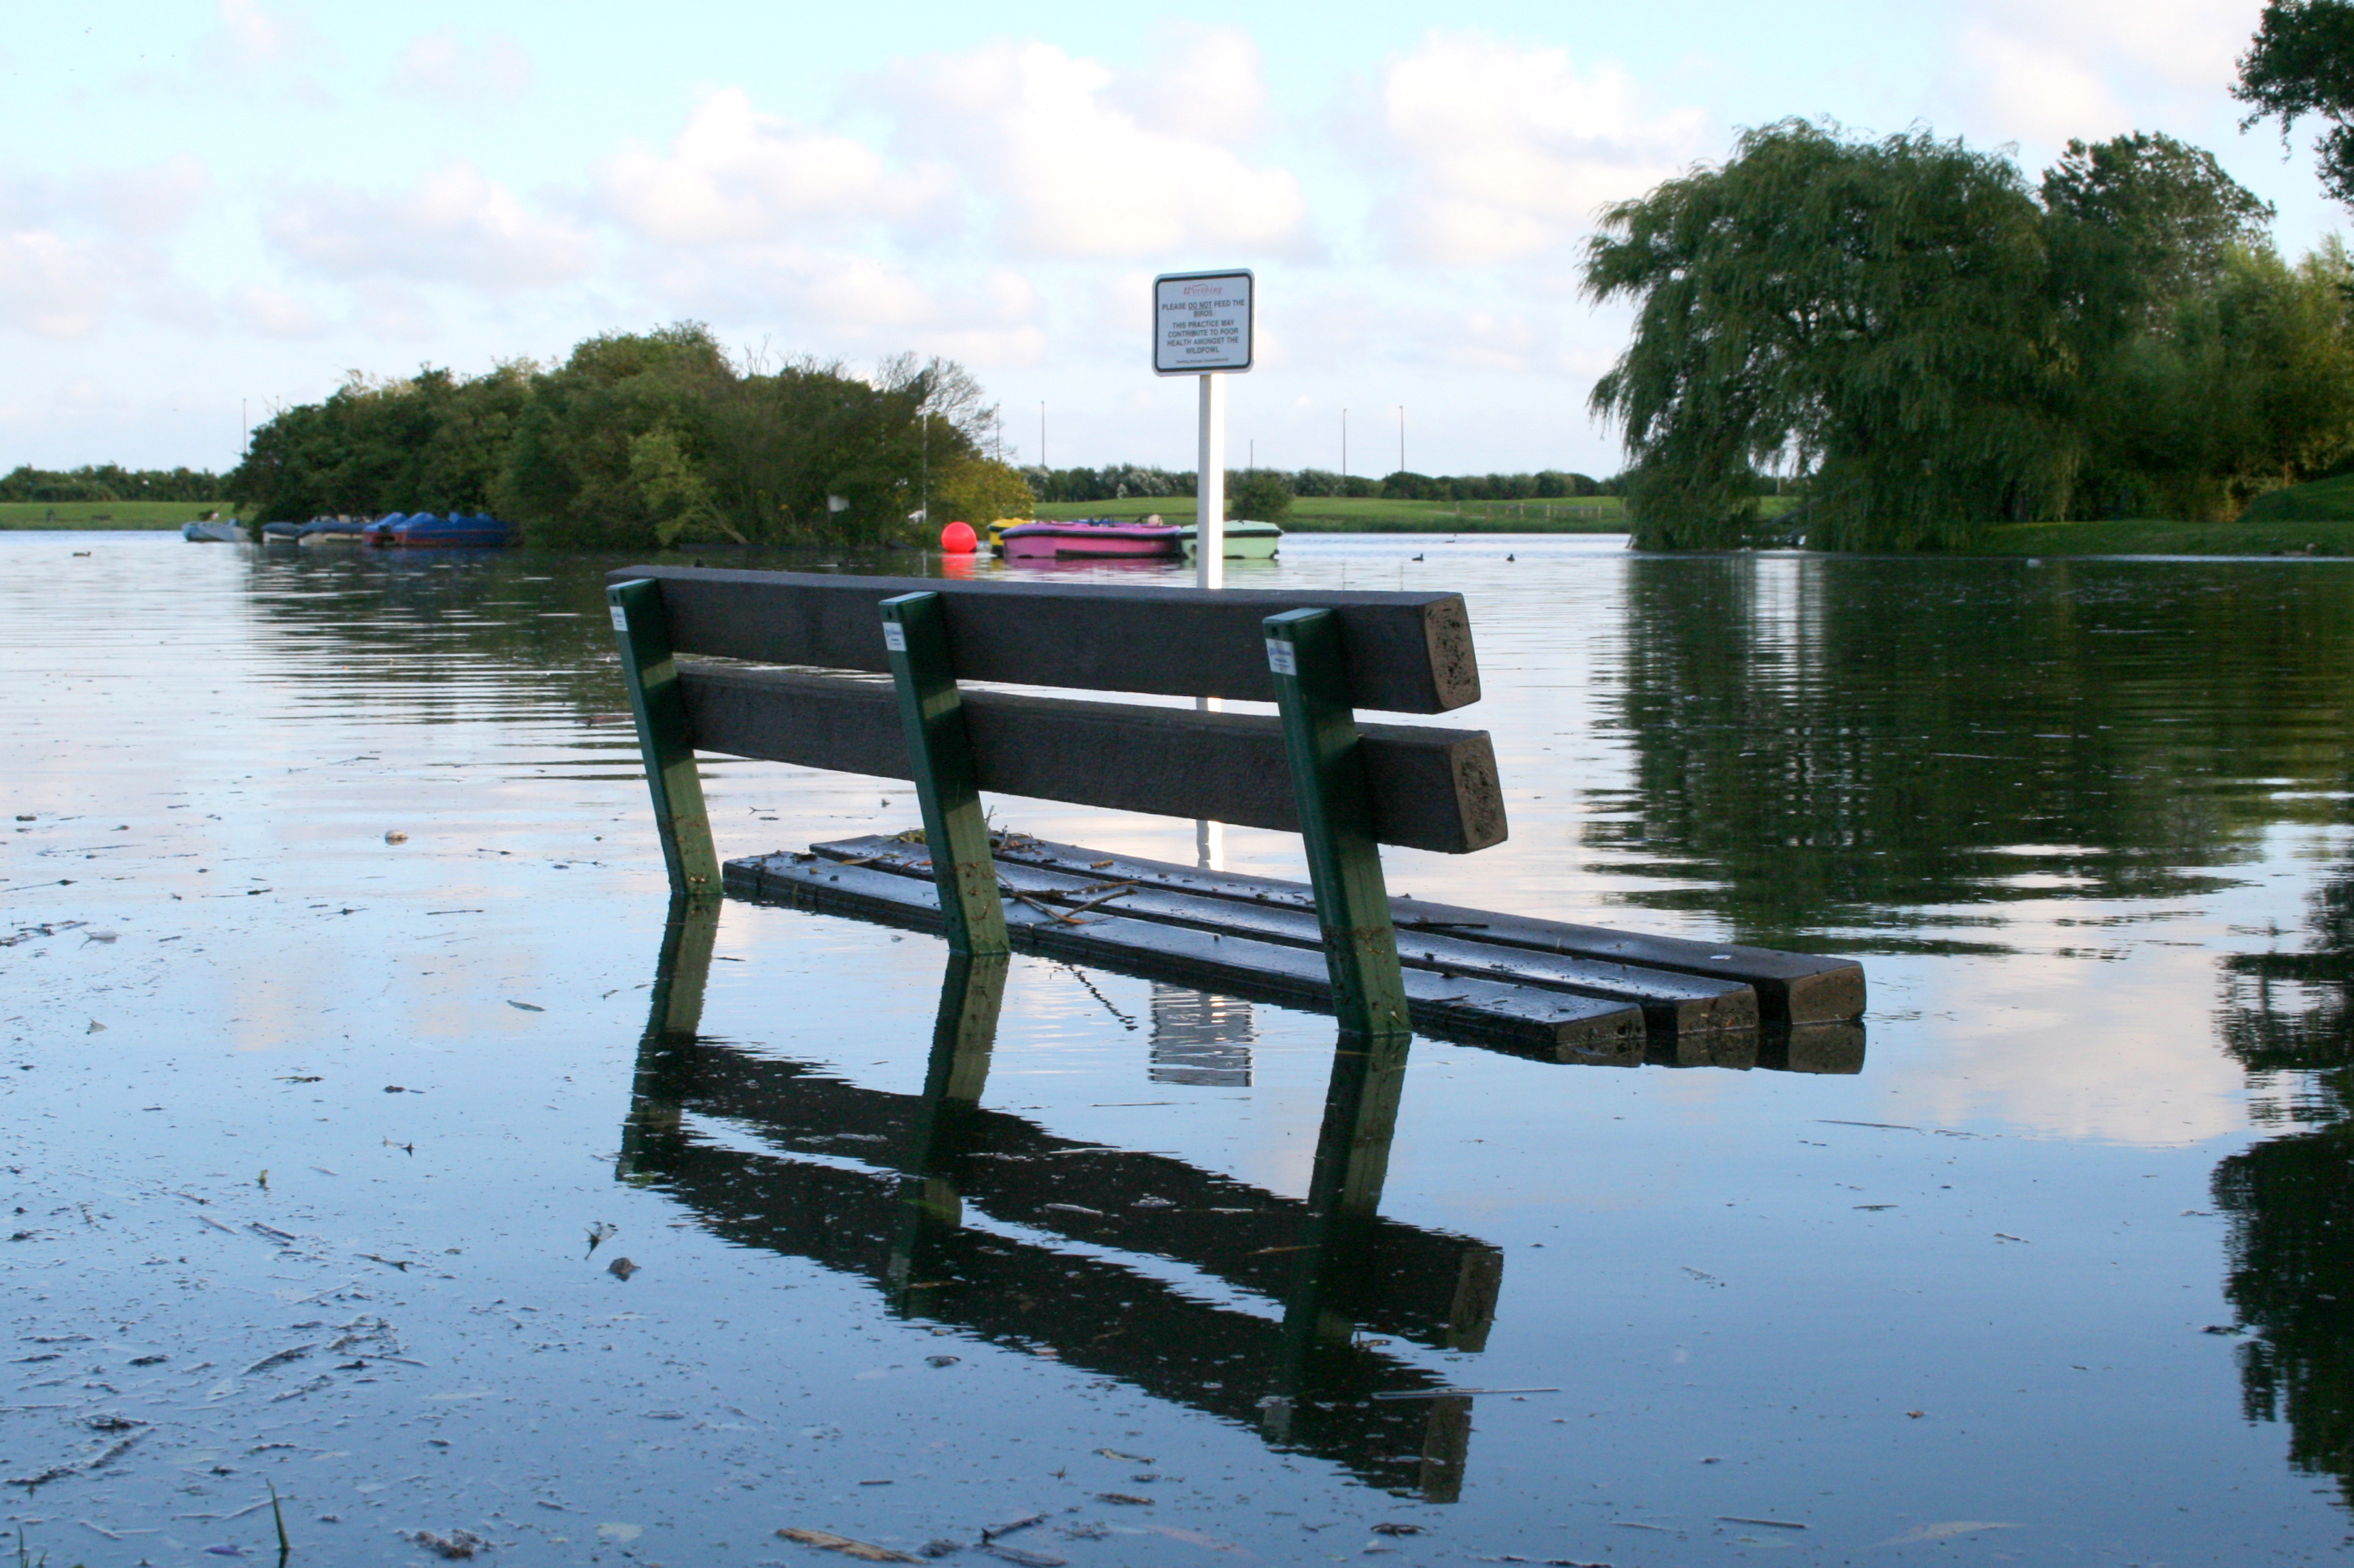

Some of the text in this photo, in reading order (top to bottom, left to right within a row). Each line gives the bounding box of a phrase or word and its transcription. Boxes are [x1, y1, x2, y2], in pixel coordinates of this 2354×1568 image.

[1183, 284, 1223, 295] Worthing
[1162, 302, 1186, 310] PLEASE
[1188, 302, 1197, 310] DO
[1199, 301, 1212, 310] NOT
[1188, 320, 1218, 328] PRACTICE
[1168, 329, 1208, 338] CONTRIBUTE
